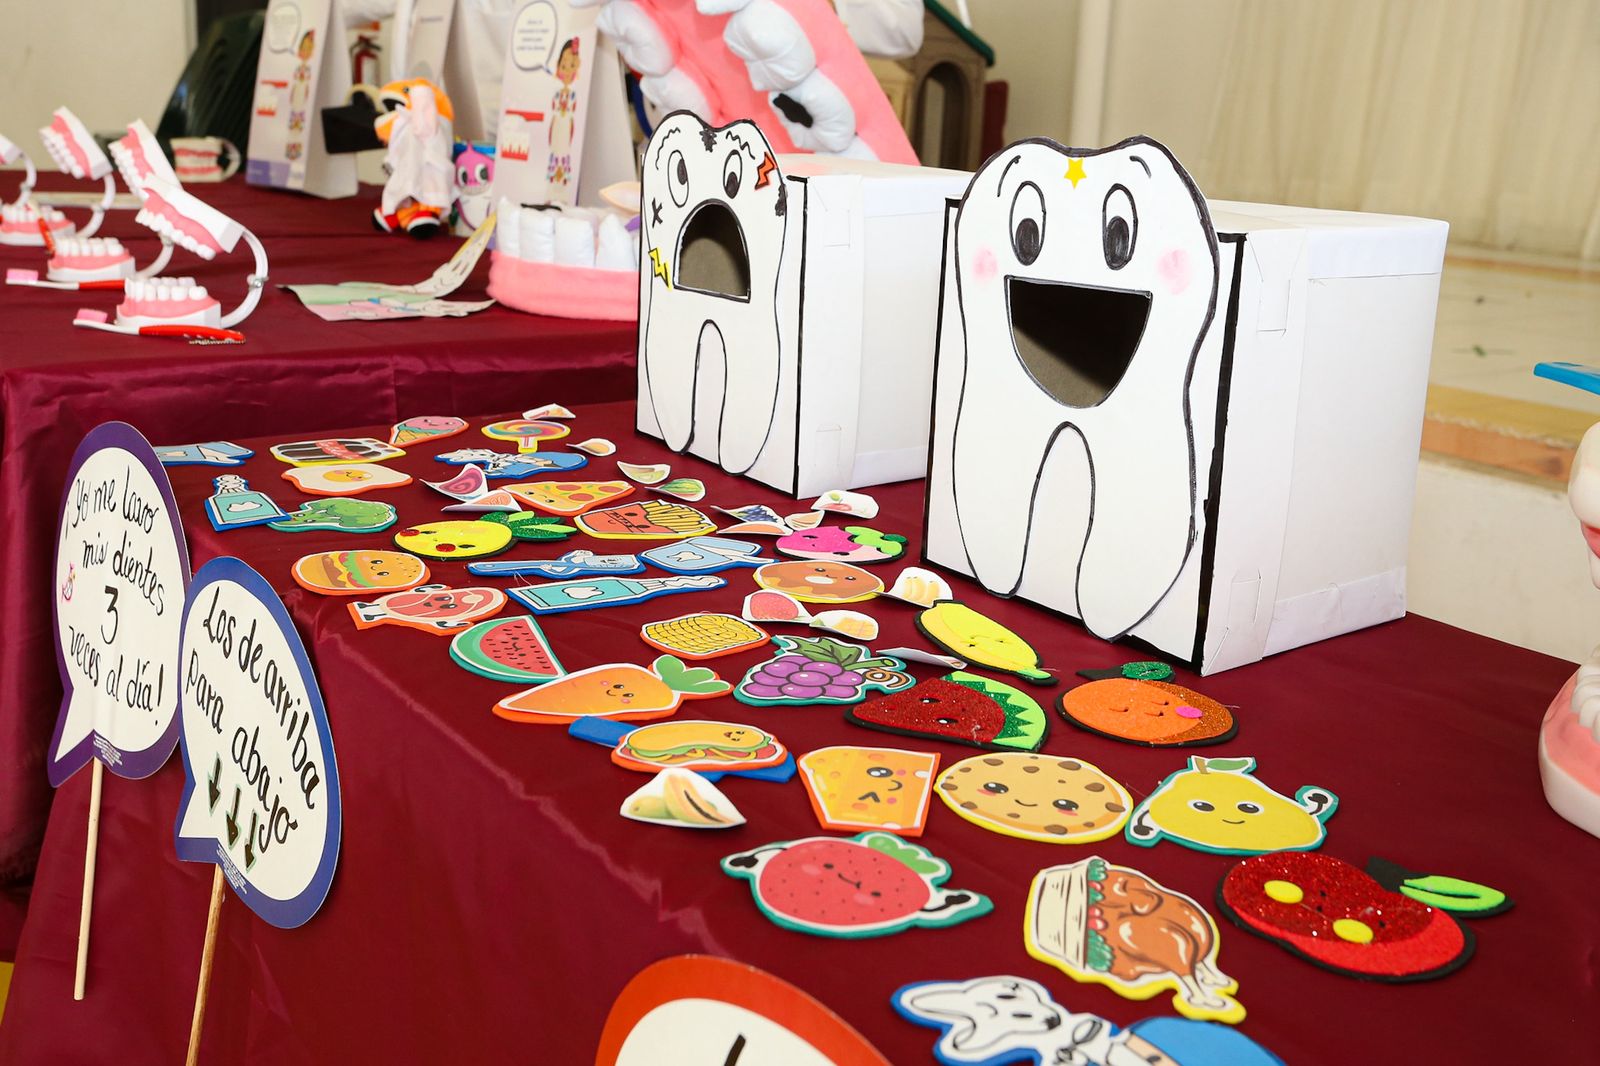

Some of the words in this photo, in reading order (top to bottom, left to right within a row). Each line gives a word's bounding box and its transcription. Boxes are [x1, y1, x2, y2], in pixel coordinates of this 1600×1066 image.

[93, 479, 117, 513] me
[122, 464, 160, 535] lavo
[82, 531, 109, 569] mis
[112, 529, 165, 617] dientes
[100, 585, 119, 645] 3
[68, 625, 101, 688] veces
[105, 654, 123, 702] al
[126, 657, 164, 726] día!
[202, 586, 237, 660] Los
[238, 618, 264, 684] de
[263, 658, 321, 811] arriba
[231, 725, 299, 854] abajo
